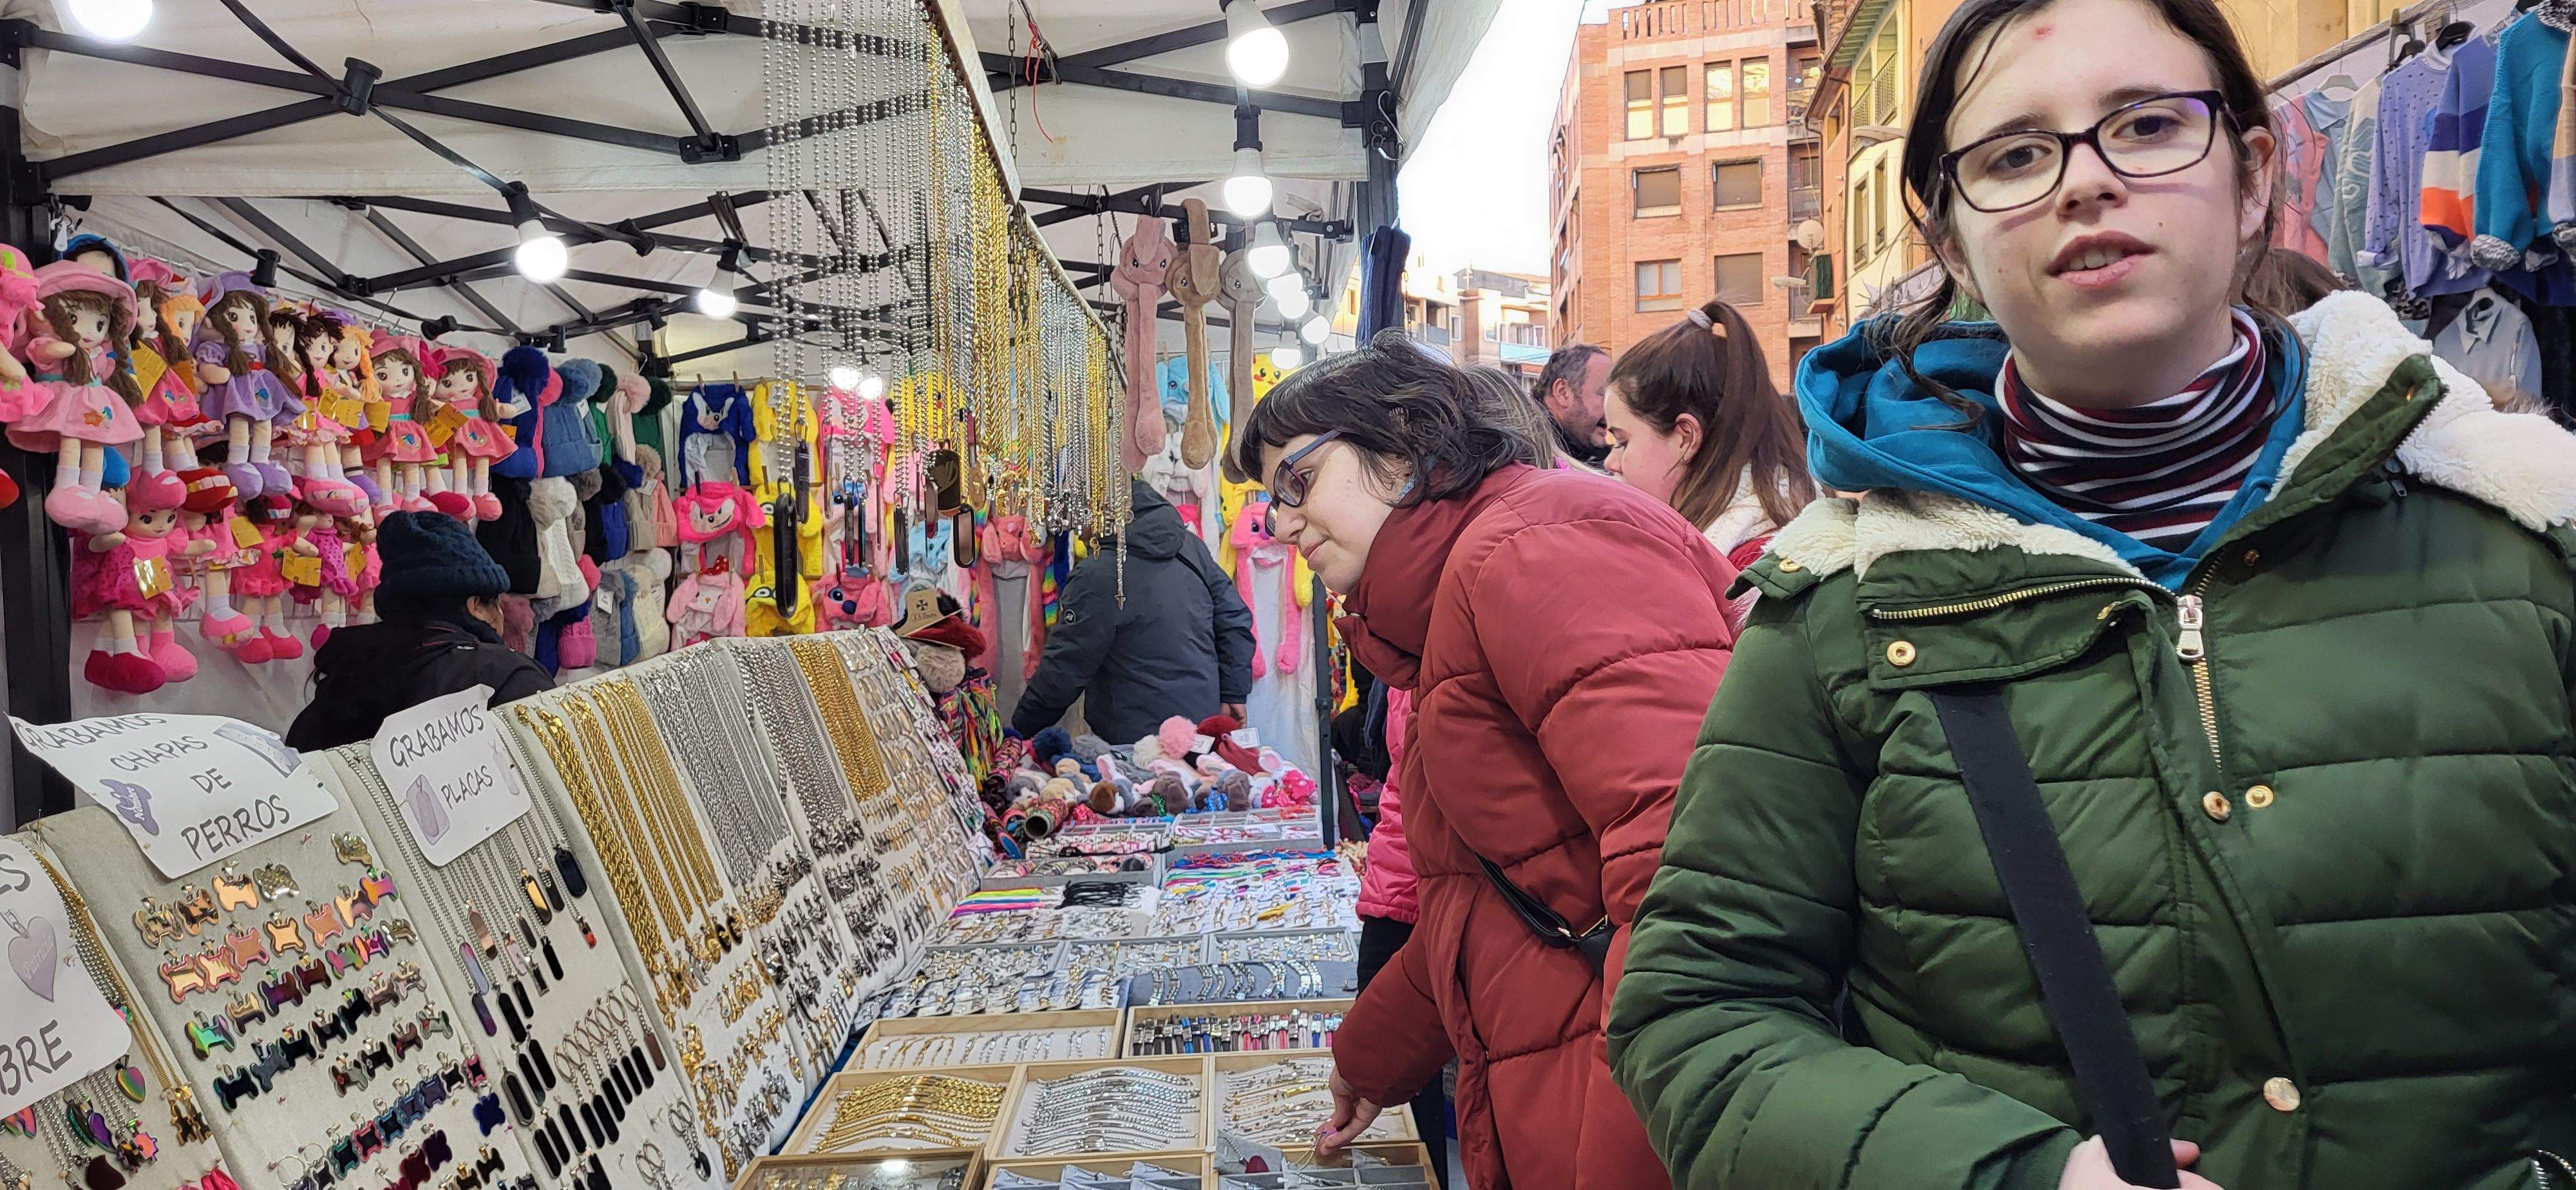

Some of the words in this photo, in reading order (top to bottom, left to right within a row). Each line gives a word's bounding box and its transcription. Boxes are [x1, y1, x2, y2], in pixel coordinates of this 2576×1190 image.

[15, 715, 167, 751] GRABAMOS
[110, 735, 208, 771] CHAPAS
[390, 703, 484, 768] GRABAMOS
[189, 768, 232, 793] DE
[440, 764, 493, 810] PLACAS
[180, 794, 290, 861] PERROS
